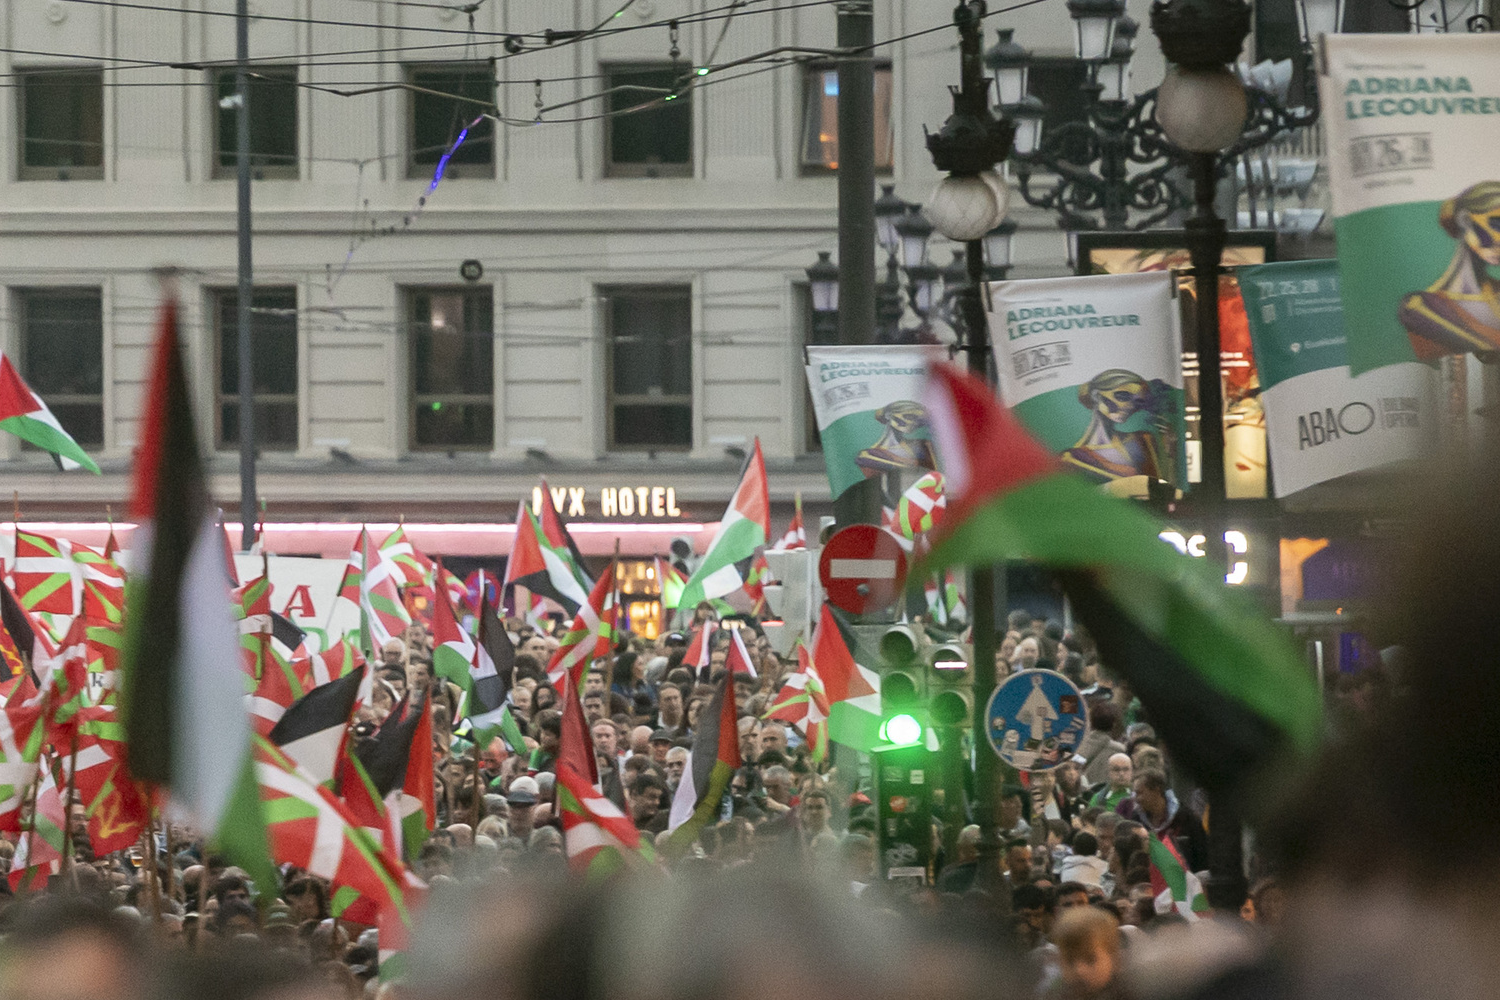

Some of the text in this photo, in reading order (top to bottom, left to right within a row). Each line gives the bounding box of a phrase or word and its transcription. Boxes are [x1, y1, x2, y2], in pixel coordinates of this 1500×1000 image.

[1344, 76, 1473, 95] ADRIANA
[1346, 97, 1500, 120] LECOUVRE
[1006, 304, 1096, 325] ADRIANA
[1007, 315, 1140, 340] LECOUVREUR
[820, 361, 890, 371] ADRIANA
[1299, 401, 1375, 451] ABAO
[601, 486, 681, 517] HOTEL
